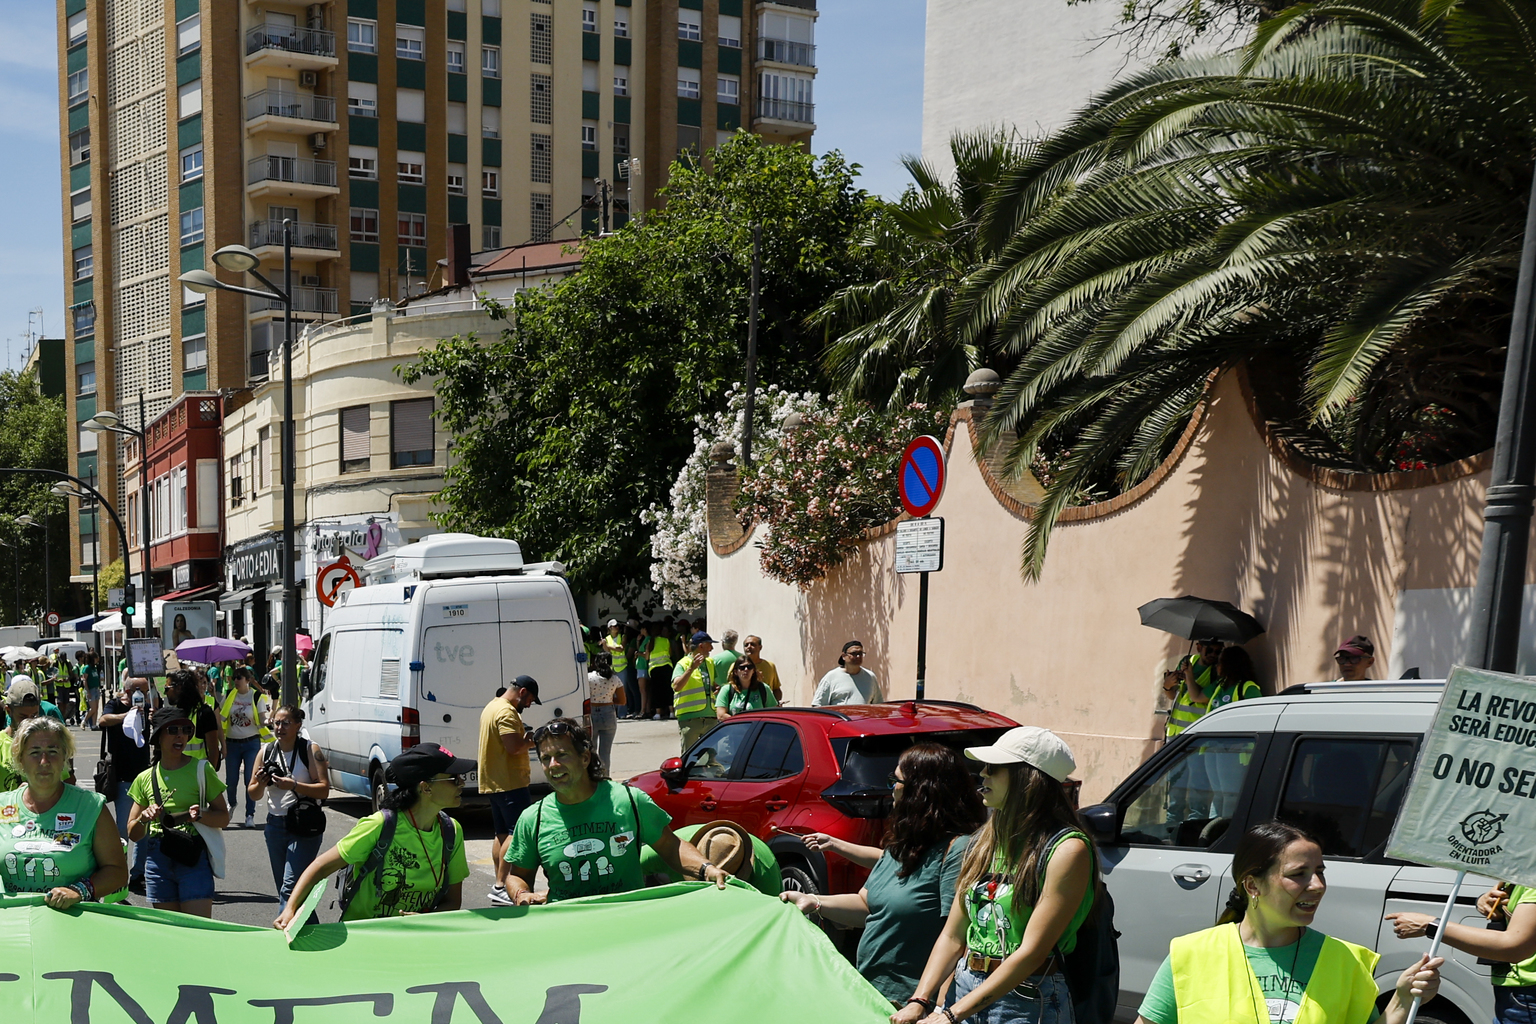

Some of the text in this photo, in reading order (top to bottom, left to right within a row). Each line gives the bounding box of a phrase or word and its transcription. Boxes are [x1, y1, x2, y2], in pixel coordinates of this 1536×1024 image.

[448, 609, 465, 617] 1910
[434, 641, 475, 666] tve
[1457, 689, 1482, 713] LA
[1448, 714, 1491, 739] SERÀ
[1432, 753, 1454, 780] O
[1455, 757, 1496, 790] NO
[553, 822, 616, 845] ESTIMEM
[1447, 834, 1504, 858] ORIENTADORA
[1448, 848, 1491, 865] EN LLUITA
